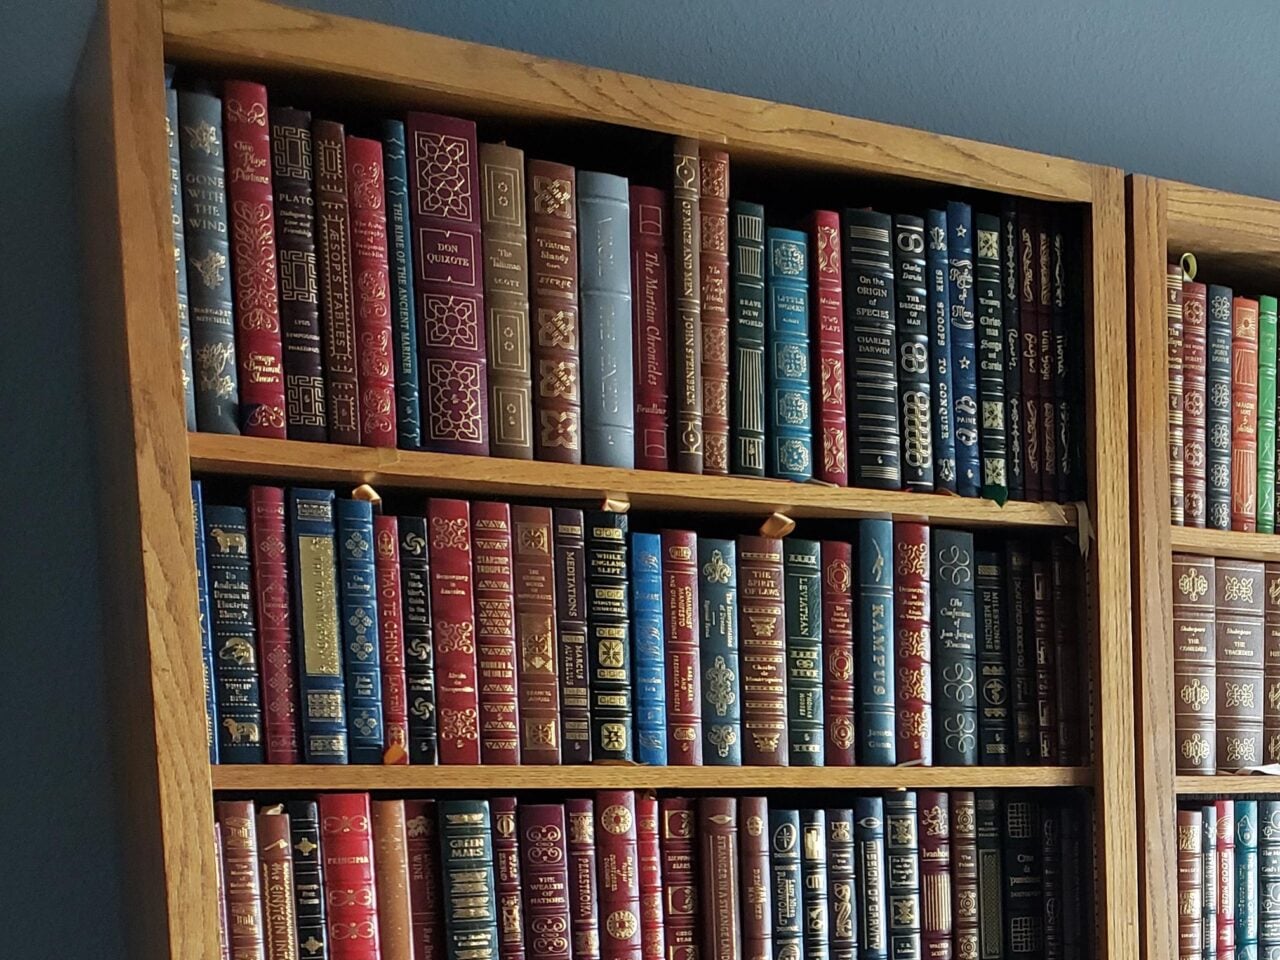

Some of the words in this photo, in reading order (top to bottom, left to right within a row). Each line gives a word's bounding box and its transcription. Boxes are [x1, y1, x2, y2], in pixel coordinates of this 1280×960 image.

[186, 174, 224, 188] GONE
[188, 189, 223, 203] WITH
[280, 193, 313, 206] PLATO
[194, 204, 220, 216] THE
[393, 202, 403, 221] THE
[682, 201, 691, 217] OF
[189, 218, 226, 232] WIND
[683, 217, 692, 245] MICE
[394, 224, 404, 248] RIME
[329, 227, 342, 283] ÆSOP'S
[396, 250, 405, 263] OF
[438, 243, 457, 252] DON
[427, 253, 469, 267] QUIXOTE
[645, 252, 660, 274] The
[683, 247, 693, 270] AND
[397, 265, 406, 286] THE
[684, 271, 693, 297] MEN
[860, 276, 870, 286] On
[872, 276, 884, 286] the
[646, 276, 659, 323] Martian
[857, 286, 888, 298] ORIGIN
[398, 289, 408, 325] ANCIENT
[740, 299, 761, 308] BRAVE
[869, 298, 876, 306] of
[332, 292, 346, 347] FABLES
[742, 309, 758, 317] NEW
[856, 308, 889, 320] SPECIES
[683, 315, 694, 346] JOHN
[739, 319, 763, 327] WORLD
[936, 302, 945, 346] STOOPS
[400, 327, 412, 374] MARINER
[857, 336, 890, 346] CHARLES
[859, 345, 890, 354] DARWIN
[647, 325, 662, 386] Chronicles
[938, 358, 946, 373] TO
[685, 346, 696, 405] STEINBECK
[940, 382, 948, 439] CONQUER
[957, 416, 976, 424] PAINE
[382, 569, 396, 598] TAO
[566, 552, 577, 617] MEDITATIONS
[748, 578, 776, 587] SPIRIT
[752, 571, 771, 579] THE
[759, 587, 780, 596] LAWS
[984, 592, 990, 603] IN
[383, 601, 396, 617] TE
[799, 578, 808, 636] LEVIATHAN
[992, 592, 1001, 650] MILESTONES
[384, 621, 399, 663] CHING
[872, 604, 885, 695] KAMPUS
[564, 645, 573, 685] AURELIUS
[575, 645, 583, 680] MARCUS
[450, 839, 484, 848] GREEN
[451, 848, 484, 857] MARS
[717, 835, 727, 880] STRANGER
[866, 841, 878, 886] MISSION
[923, 849, 949, 859] Ivanhoe
[1222, 852, 1230, 884] BLOOD
[531, 883, 564, 891] WEALTH
[578, 858, 592, 917] PERESTROIKA
[719, 881, 728, 891] IN
[720, 891, 728, 899] A
[868, 889, 879, 902] OF
[272, 883, 285, 935] EINSTEIN
[720, 900, 729, 939] STRANGE
[868, 904, 881, 950] GRAVITY
[721, 939, 730, 960] LAND
